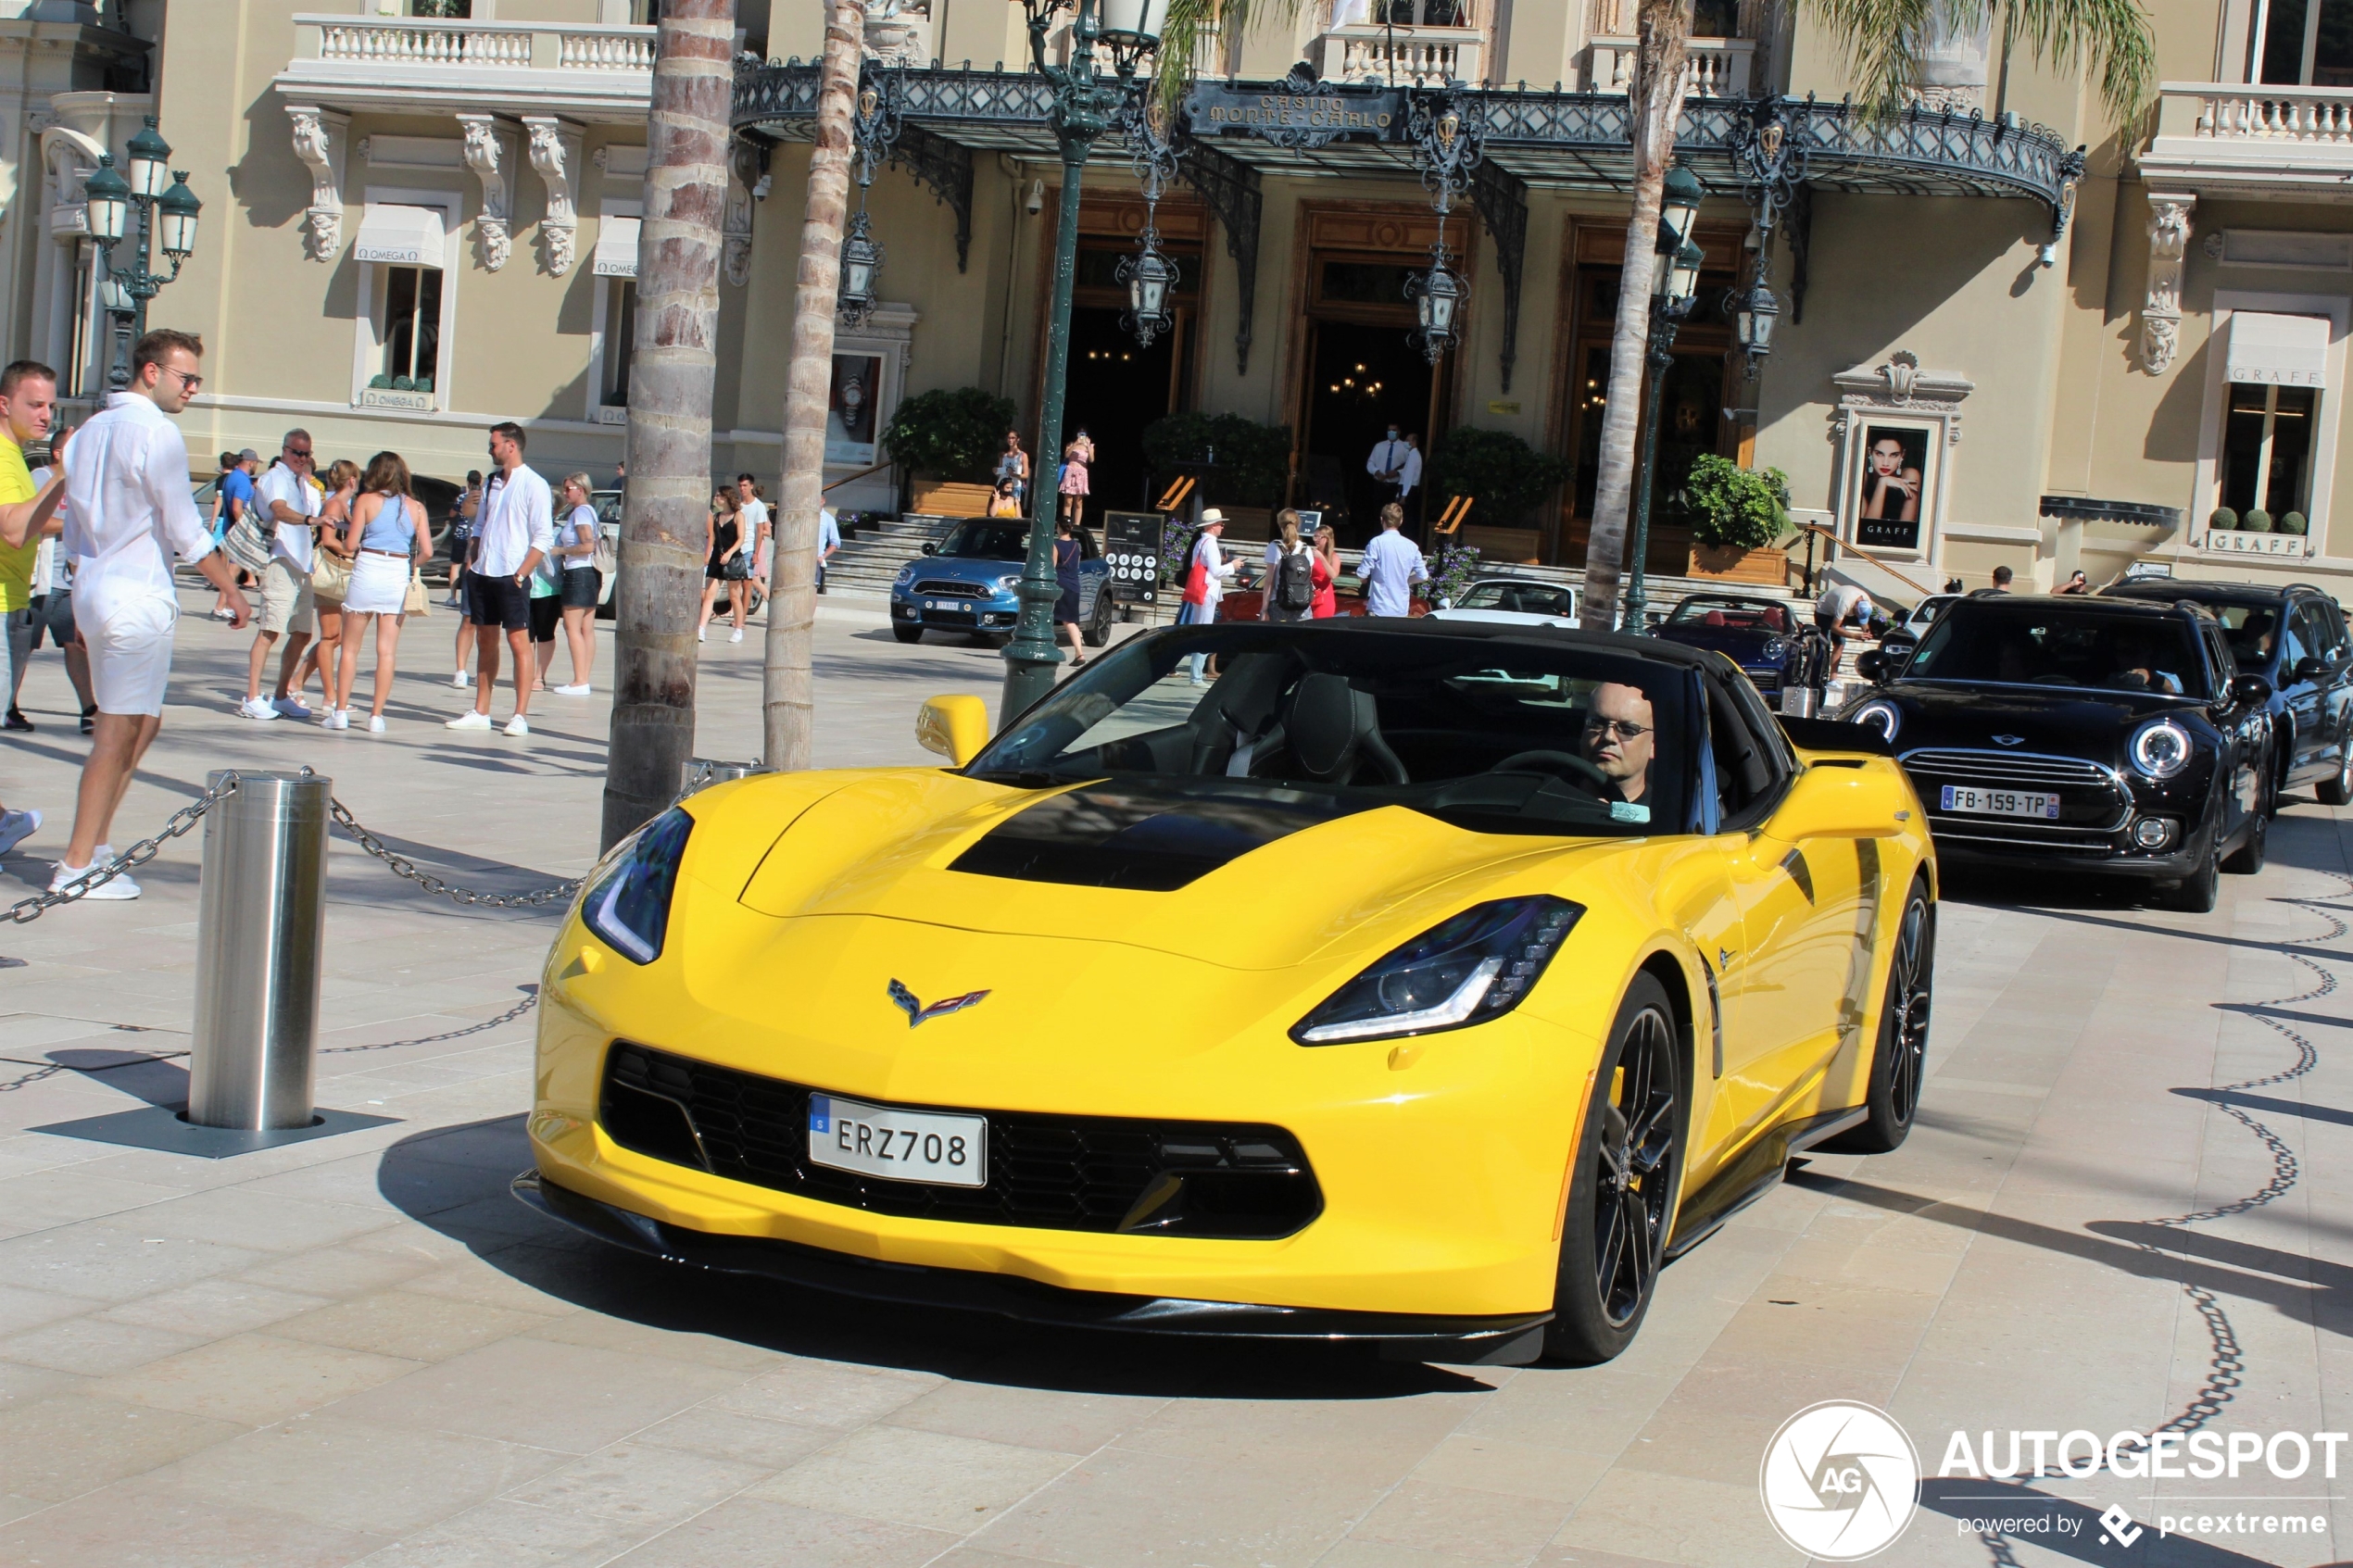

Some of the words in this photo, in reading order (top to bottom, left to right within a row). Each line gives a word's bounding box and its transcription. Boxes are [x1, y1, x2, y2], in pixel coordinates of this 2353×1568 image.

[1260, 95, 1343, 111] CASINO
[371, 250, 406, 260] OMEGA
[2233, 368, 2318, 384] GRAFF
[378, 395, 414, 407] OMEGA
[1867, 525, 1908, 535] GRAFF
[2214, 535, 2297, 554] GRAFF
[1955, 790, 2045, 813] FB-159-TP
[2047, 806, 2057, 816] 75
[817, 1120, 823, 1129] S
[837, 1119, 967, 1166] ERZ708
